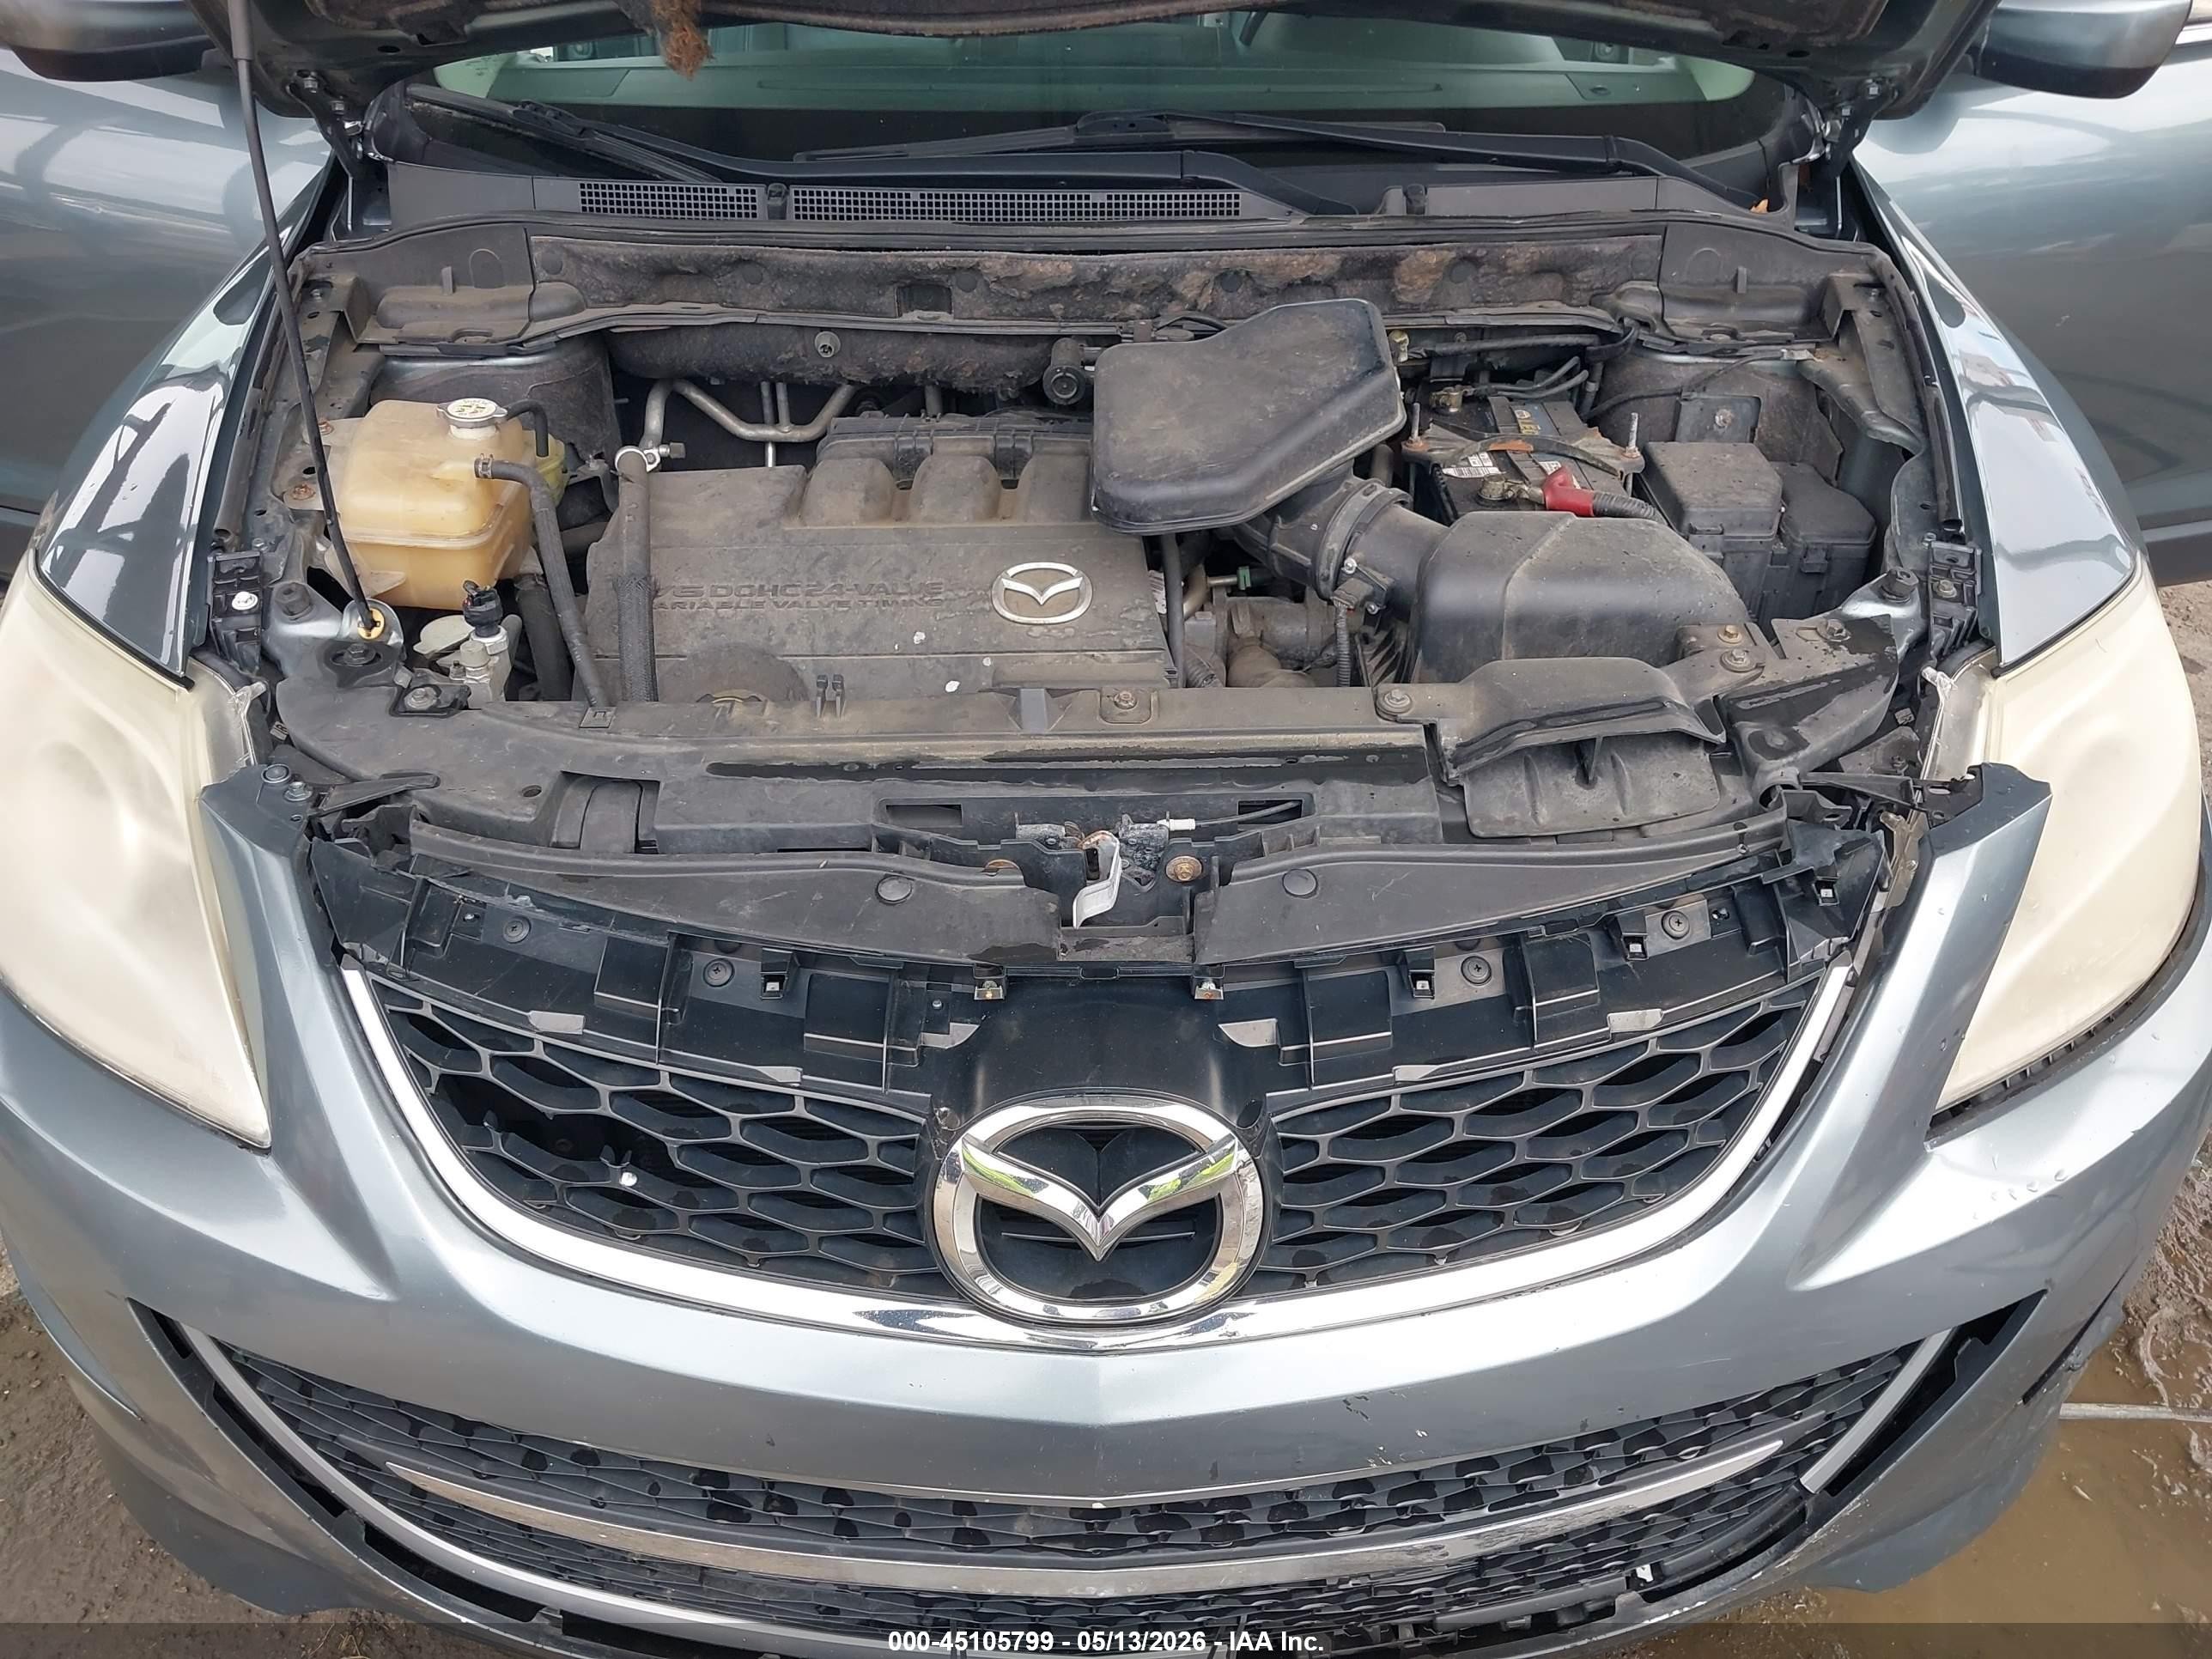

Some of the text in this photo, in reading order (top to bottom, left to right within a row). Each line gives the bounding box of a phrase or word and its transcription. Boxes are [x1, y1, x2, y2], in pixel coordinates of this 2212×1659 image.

[709, 584, 802, 598] DOHC
[804, 582, 944, 597] 24-VALVE
[653, 600, 766, 610] ARIABLE
[773, 599, 852, 609] VALVE
